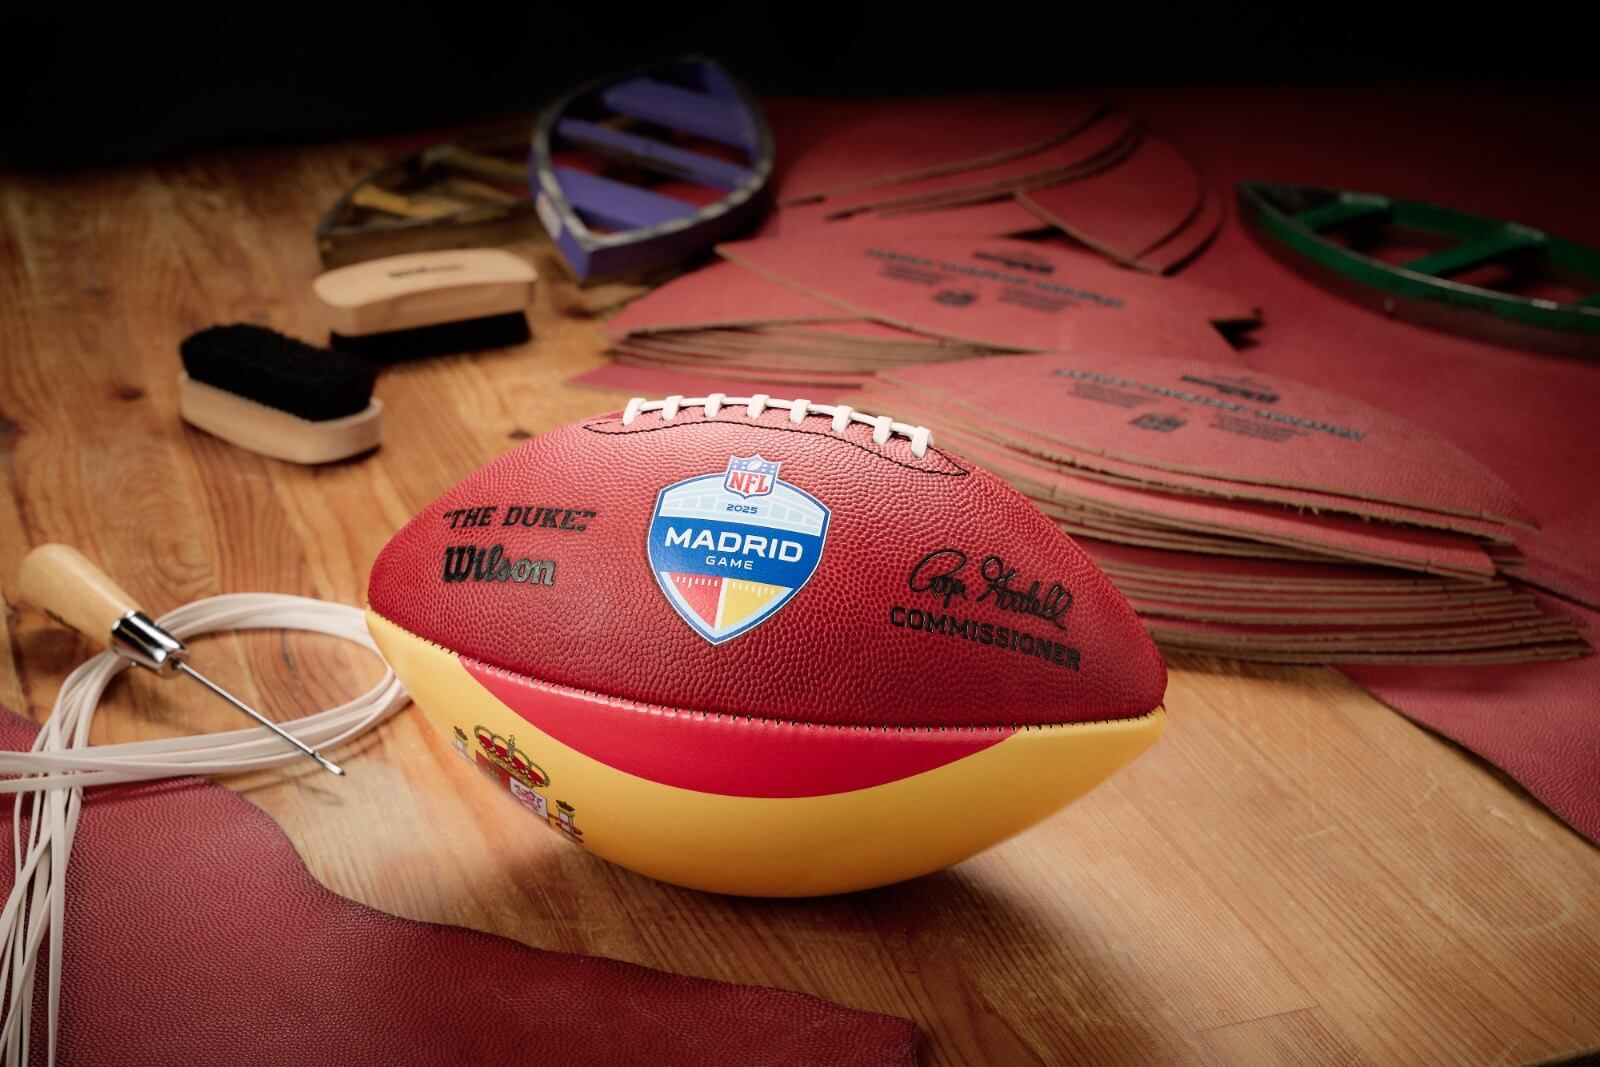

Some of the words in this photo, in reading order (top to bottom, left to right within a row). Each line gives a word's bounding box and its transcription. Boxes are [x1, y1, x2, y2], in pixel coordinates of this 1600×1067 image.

[728, 471, 769, 495] NFL
[726, 503, 759, 514] 2025
[664, 526, 804, 563] MADRID
[442, 543, 557, 586] Wilson
[705, 555, 754, 570] GAME
[890, 605, 1082, 673] COMMISSIONER
